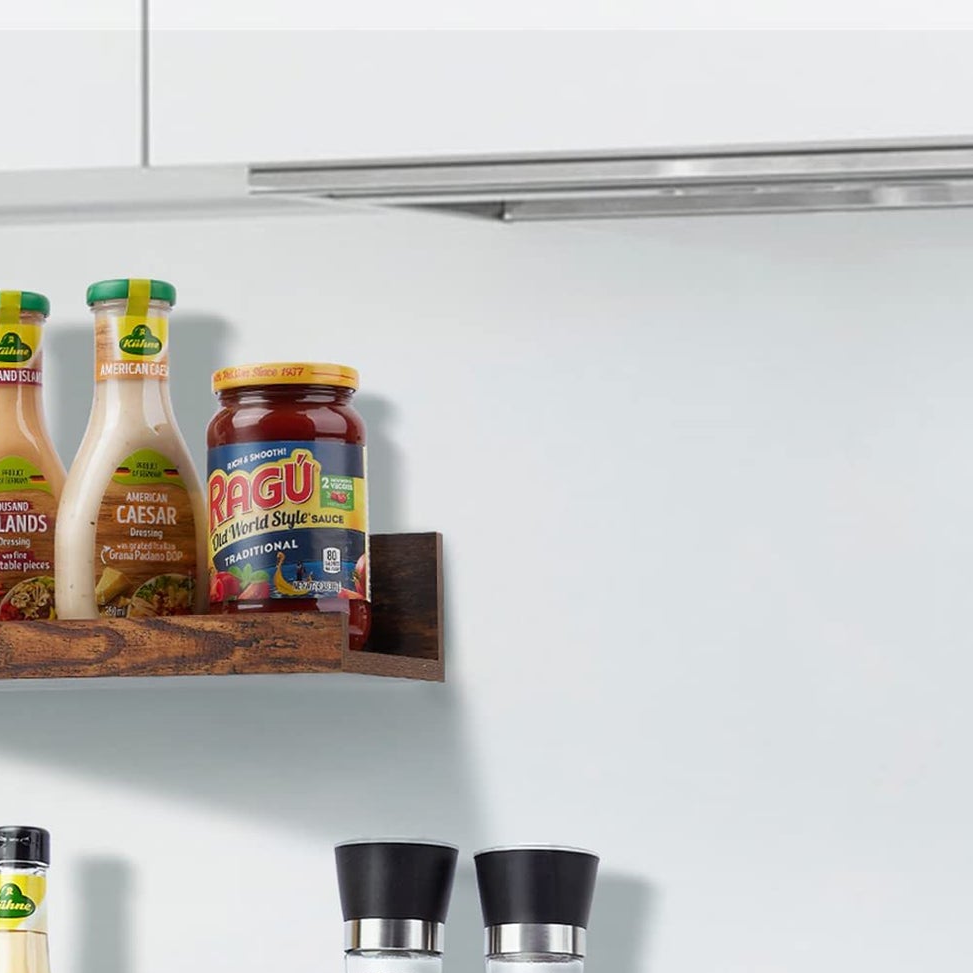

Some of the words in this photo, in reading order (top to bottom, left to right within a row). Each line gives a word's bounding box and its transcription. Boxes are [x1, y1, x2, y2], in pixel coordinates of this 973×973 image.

[123, 338, 160, 349] Kühne
[100, 361, 148, 376] AMERICAN
[281, 366, 304, 377] 1937
[227, 457, 244, 470] RICH
[243, 455, 249, 464] &
[250, 447, 287, 463] SMOOTH!
[321, 477, 330, 489] 2
[126, 491, 168, 503] AMERICAN
[208, 452, 315, 536] RAGÚ
[116, 505, 177, 525] CAESAR
[228, 516, 270, 541] World
[271, 510, 308, 530] Style
[311, 514, 345, 524] SAUCE
[130, 528, 164, 540] Dressing
[13, 551, 28, 560] fine
[109, 549, 134, 561] Grana
[134, 550, 165, 561] Padano
[166, 551, 184, 562] DOP
[224, 539, 299, 567] TRADITIONAL
[326, 550, 337, 561] 80
[23, 560, 50, 573] pieces
